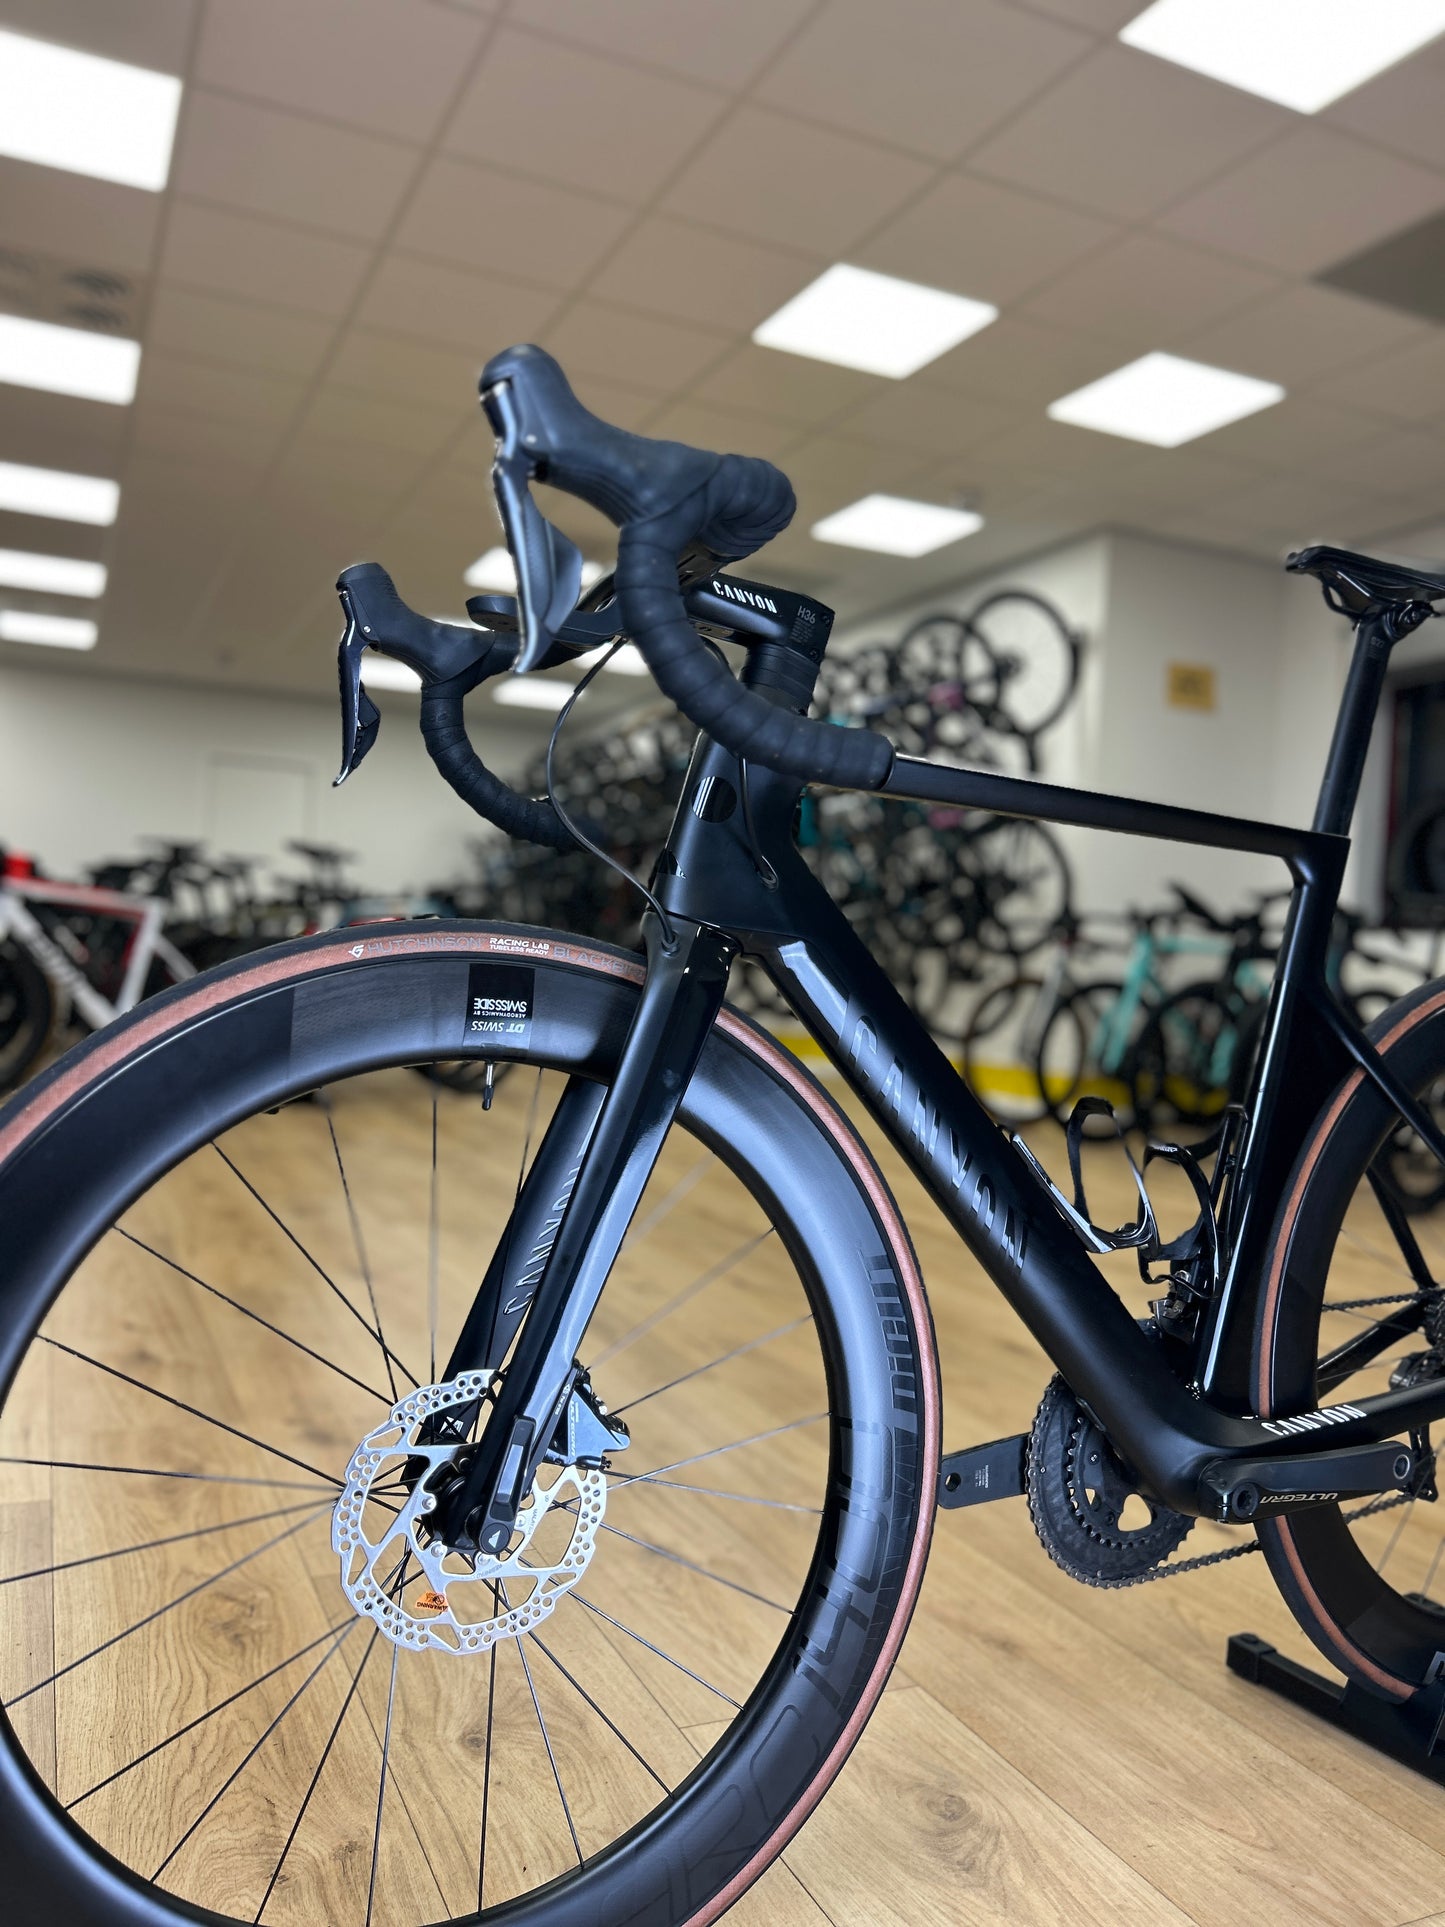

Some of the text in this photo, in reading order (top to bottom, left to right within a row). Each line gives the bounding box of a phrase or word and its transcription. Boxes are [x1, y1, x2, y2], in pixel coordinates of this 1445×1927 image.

[712, 580, 778, 614] CANYON
[797, 605, 816, 625] H36
[367, 936, 482, 956] HUTCHINSON
[489, 937, 530, 948] RACING
[531, 941, 550, 951] LAB
[489, 944, 549, 956] TUBELESS READY
[482, 1010, 527, 1018] AERODYNAMICS
[470, 1020, 526, 1034] DT SWISS
[850, 1015, 1029, 1270] CANYON
[1261, 1404, 1367, 1436] CANYON
[1260, 1492, 1339, 1504] ULTEGRA
